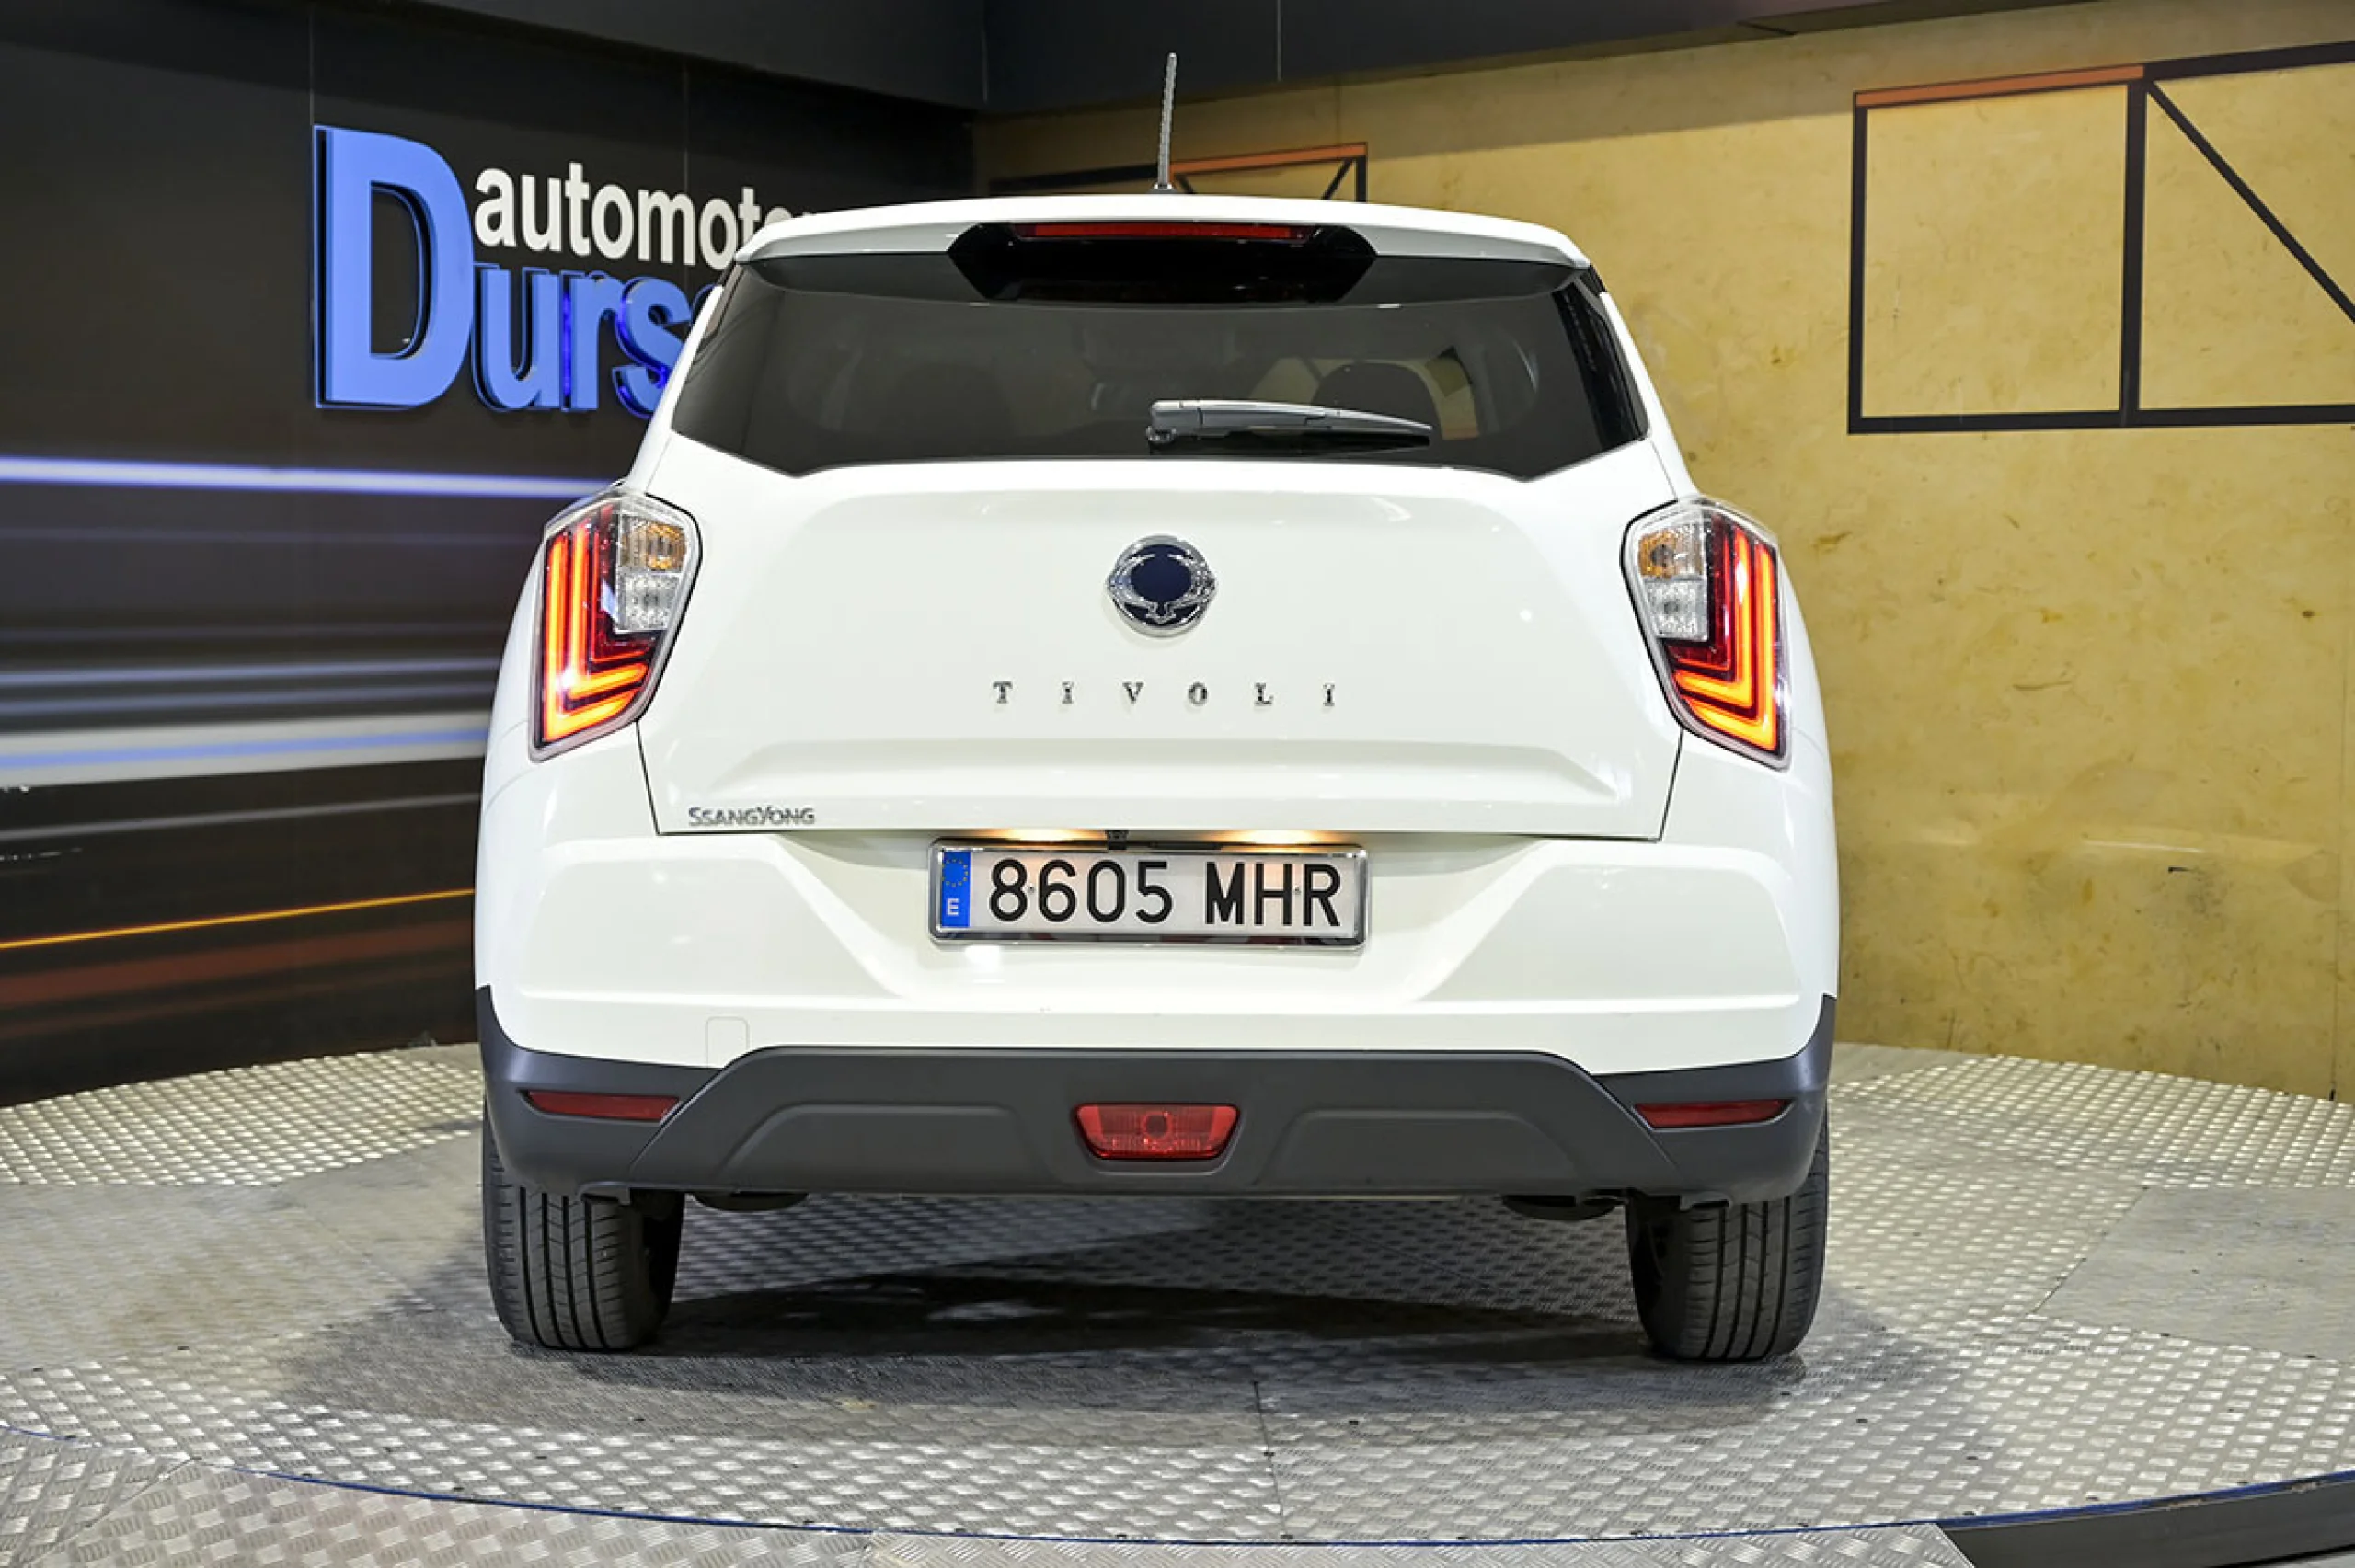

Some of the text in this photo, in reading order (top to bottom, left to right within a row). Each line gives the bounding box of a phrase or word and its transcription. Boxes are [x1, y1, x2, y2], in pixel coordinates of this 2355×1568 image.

[474, 162, 815, 269] automot
[314, 125, 721, 420] Durs
[993, 681, 1335, 707] TIVOLI
[946, 858, 1342, 927] E 8605 MHR
